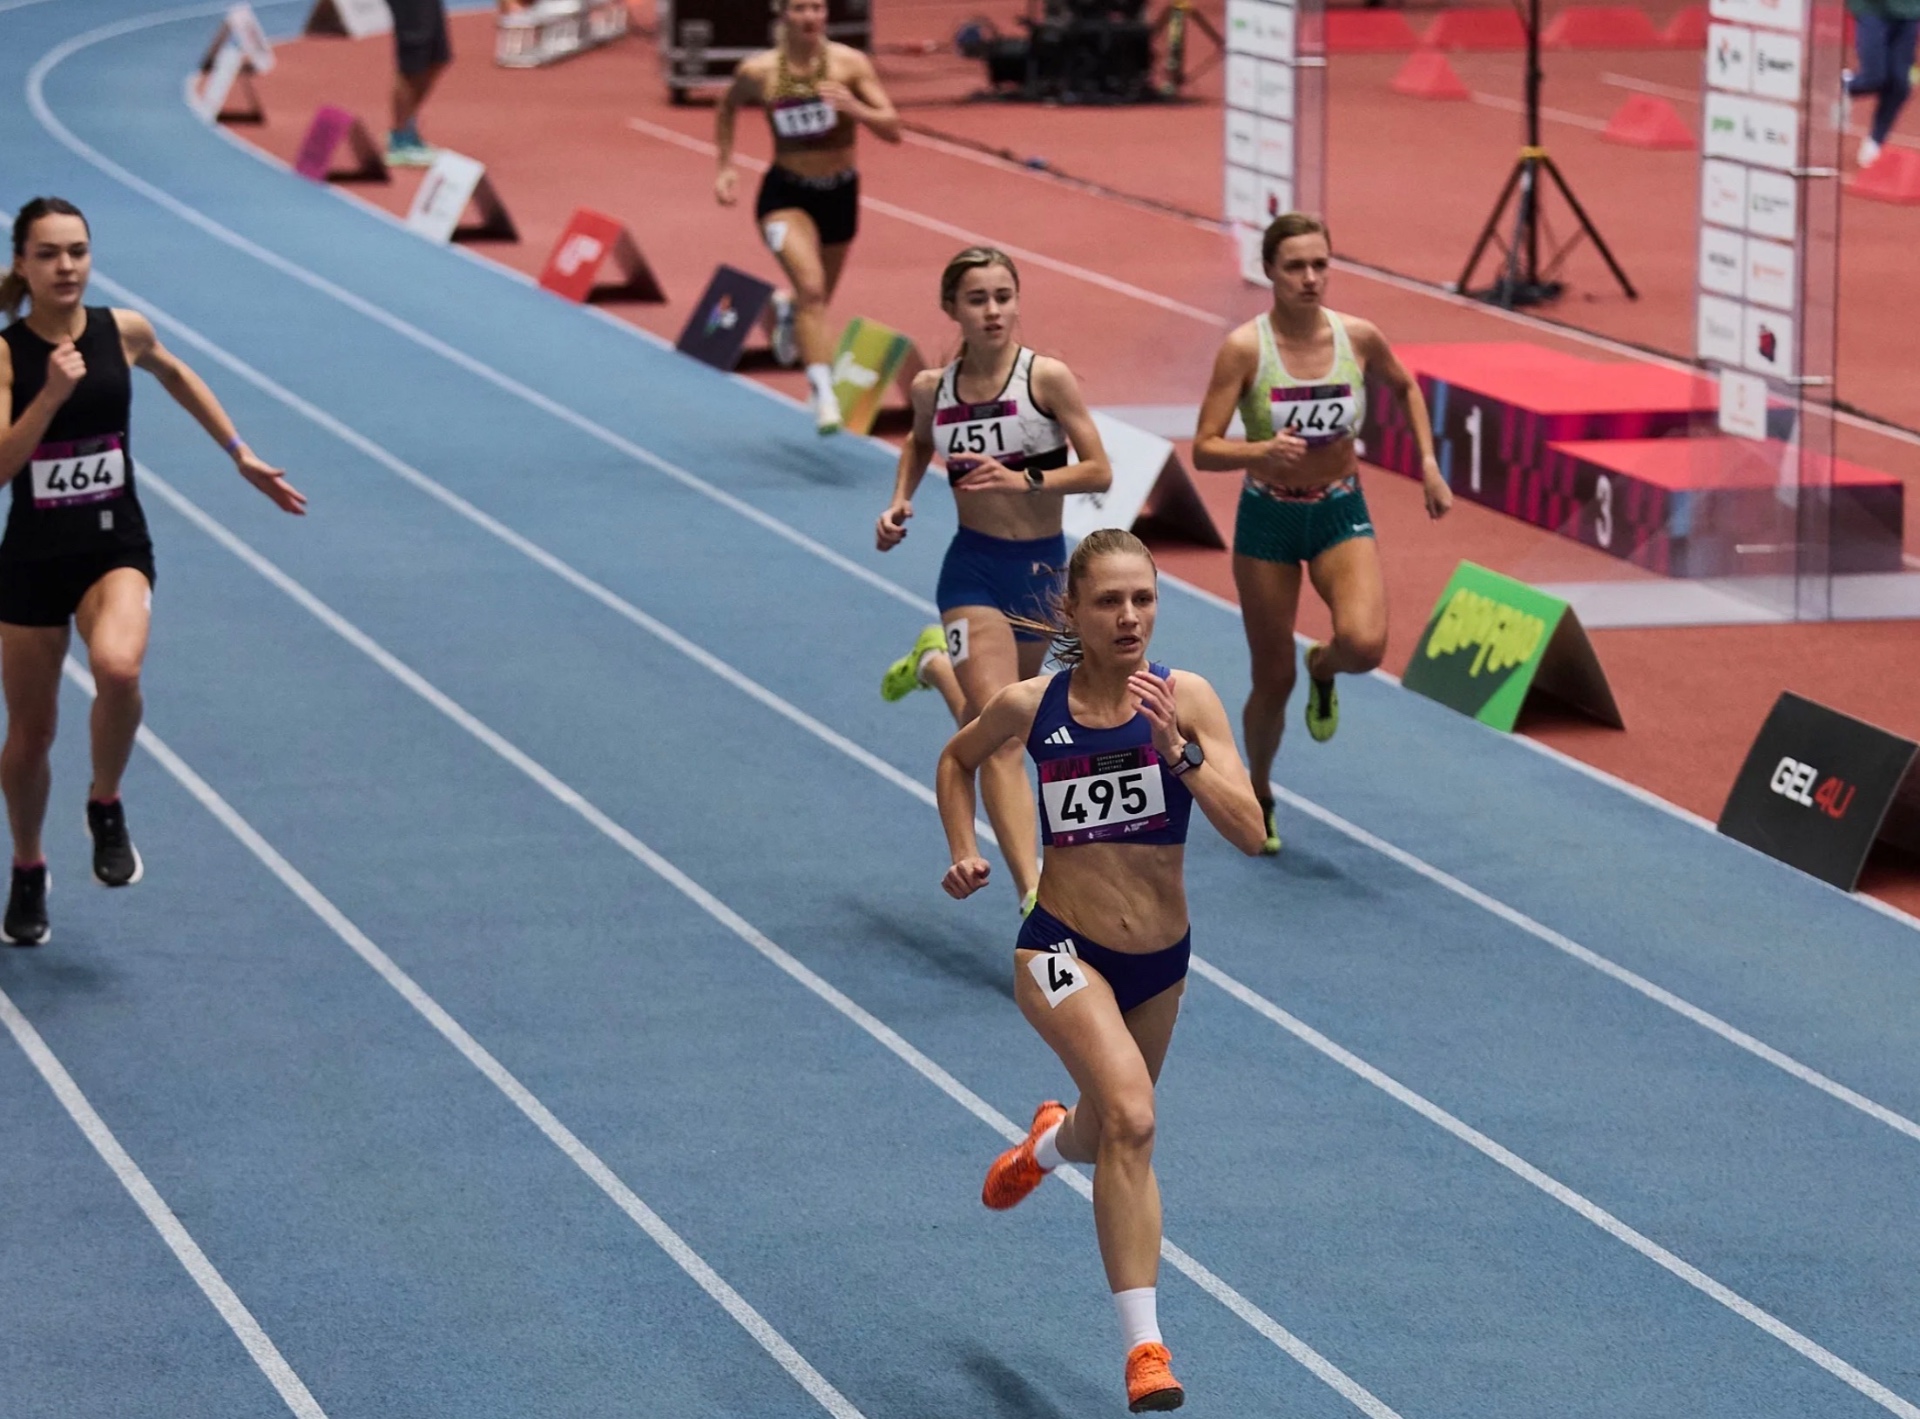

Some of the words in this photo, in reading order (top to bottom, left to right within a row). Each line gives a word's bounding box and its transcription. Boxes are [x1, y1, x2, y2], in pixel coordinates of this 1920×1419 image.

[1284, 402, 1345, 432] 442
[948, 422, 1004, 454] 451
[47, 458, 112, 491] 464
[1596, 474, 1613, 547] 3
[949, 628, 962, 657] 3
[1060, 773, 1147, 824] 495
[1048, 956, 1074, 993] 4
